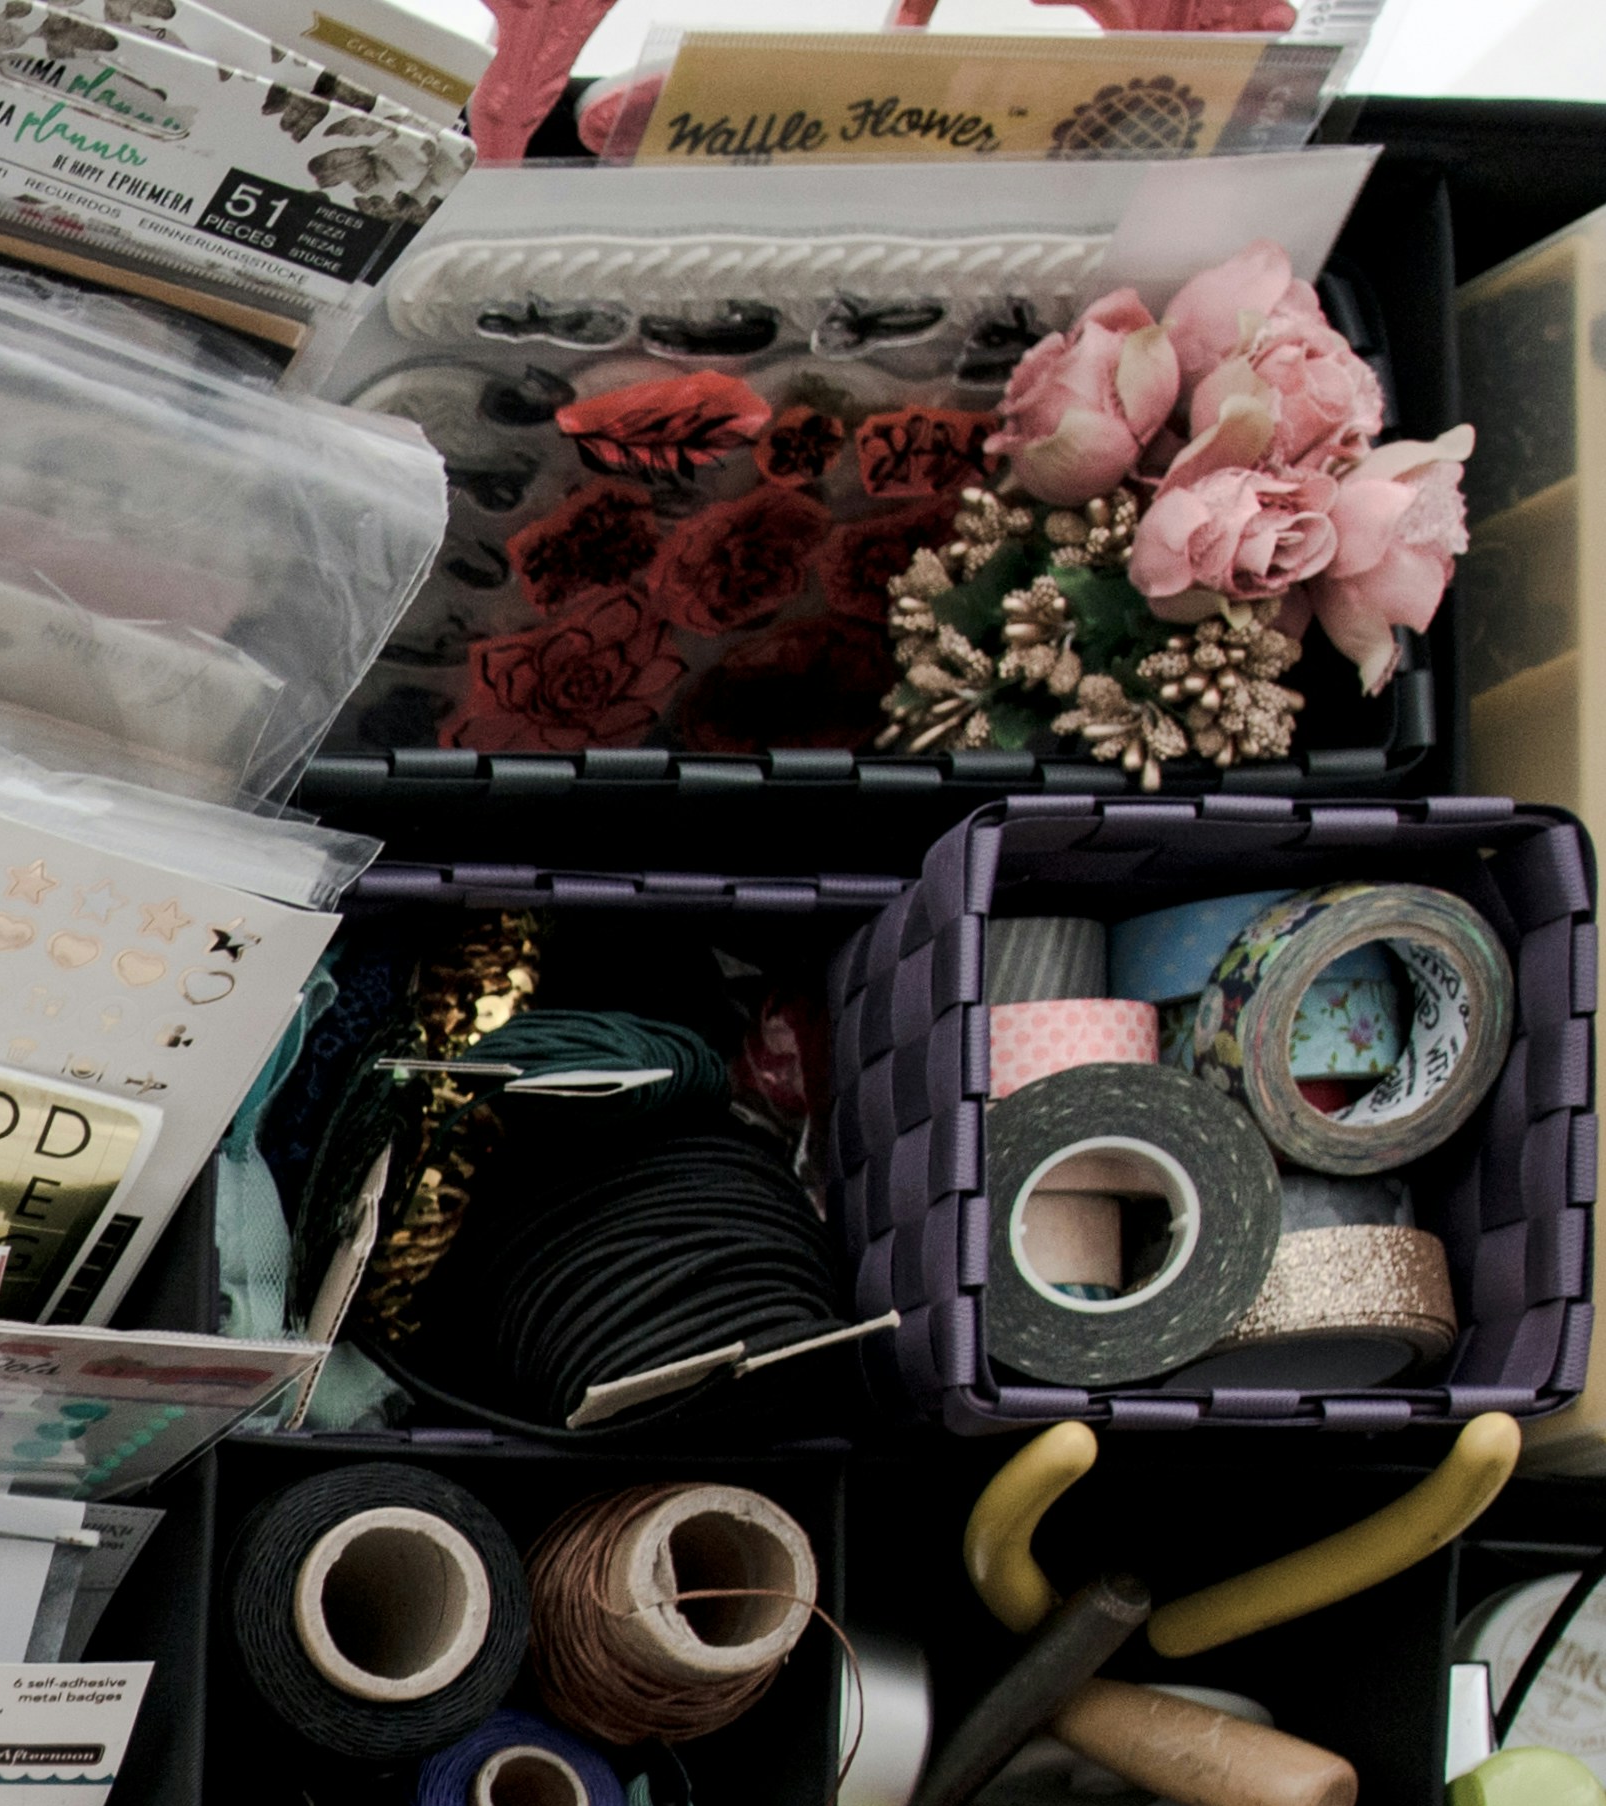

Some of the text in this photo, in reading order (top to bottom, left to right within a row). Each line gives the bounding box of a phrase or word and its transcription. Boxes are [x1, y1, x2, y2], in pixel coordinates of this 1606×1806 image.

[14, 101, 148, 167] planner
[665, 96, 1002, 165] Waffle Flower
[24, 177, 122, 220] RECUERDOS
[53, 153, 195, 215] BE HAPPY EPHEMERA
[224, 183, 290, 229] 51
[203, 214, 277, 249] PIECES
[13, 1676, 127, 1689] 6 self-adhesive
[18, 1691, 123, 1706] metal badges
